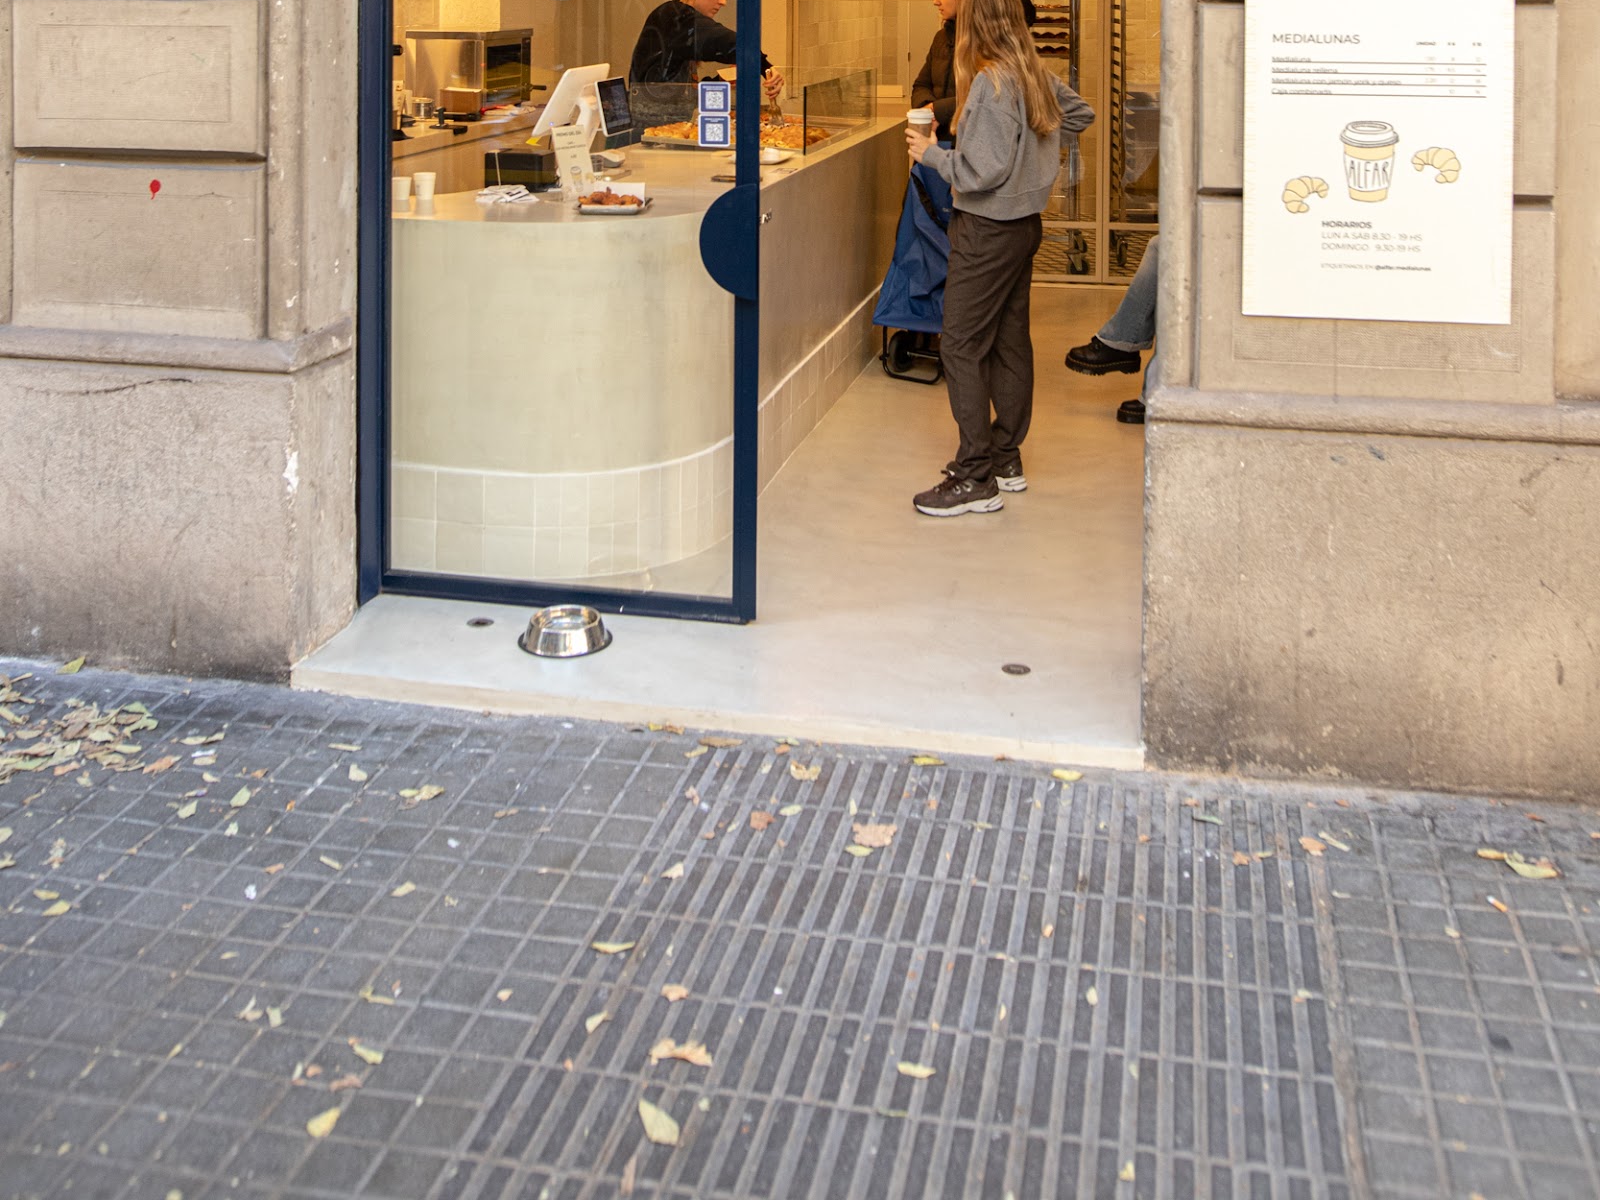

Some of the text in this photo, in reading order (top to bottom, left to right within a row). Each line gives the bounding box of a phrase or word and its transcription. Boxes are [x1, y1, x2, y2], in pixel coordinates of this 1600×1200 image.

[1272, 34, 1360, 44] MEDIALUNAS
[1348, 160, 1389, 188] ALFAR
[1321, 220, 1372, 229] HORARIOS
[1321, 243, 1370, 251] DOMINGO
[1408, 245, 1421, 253] HS
